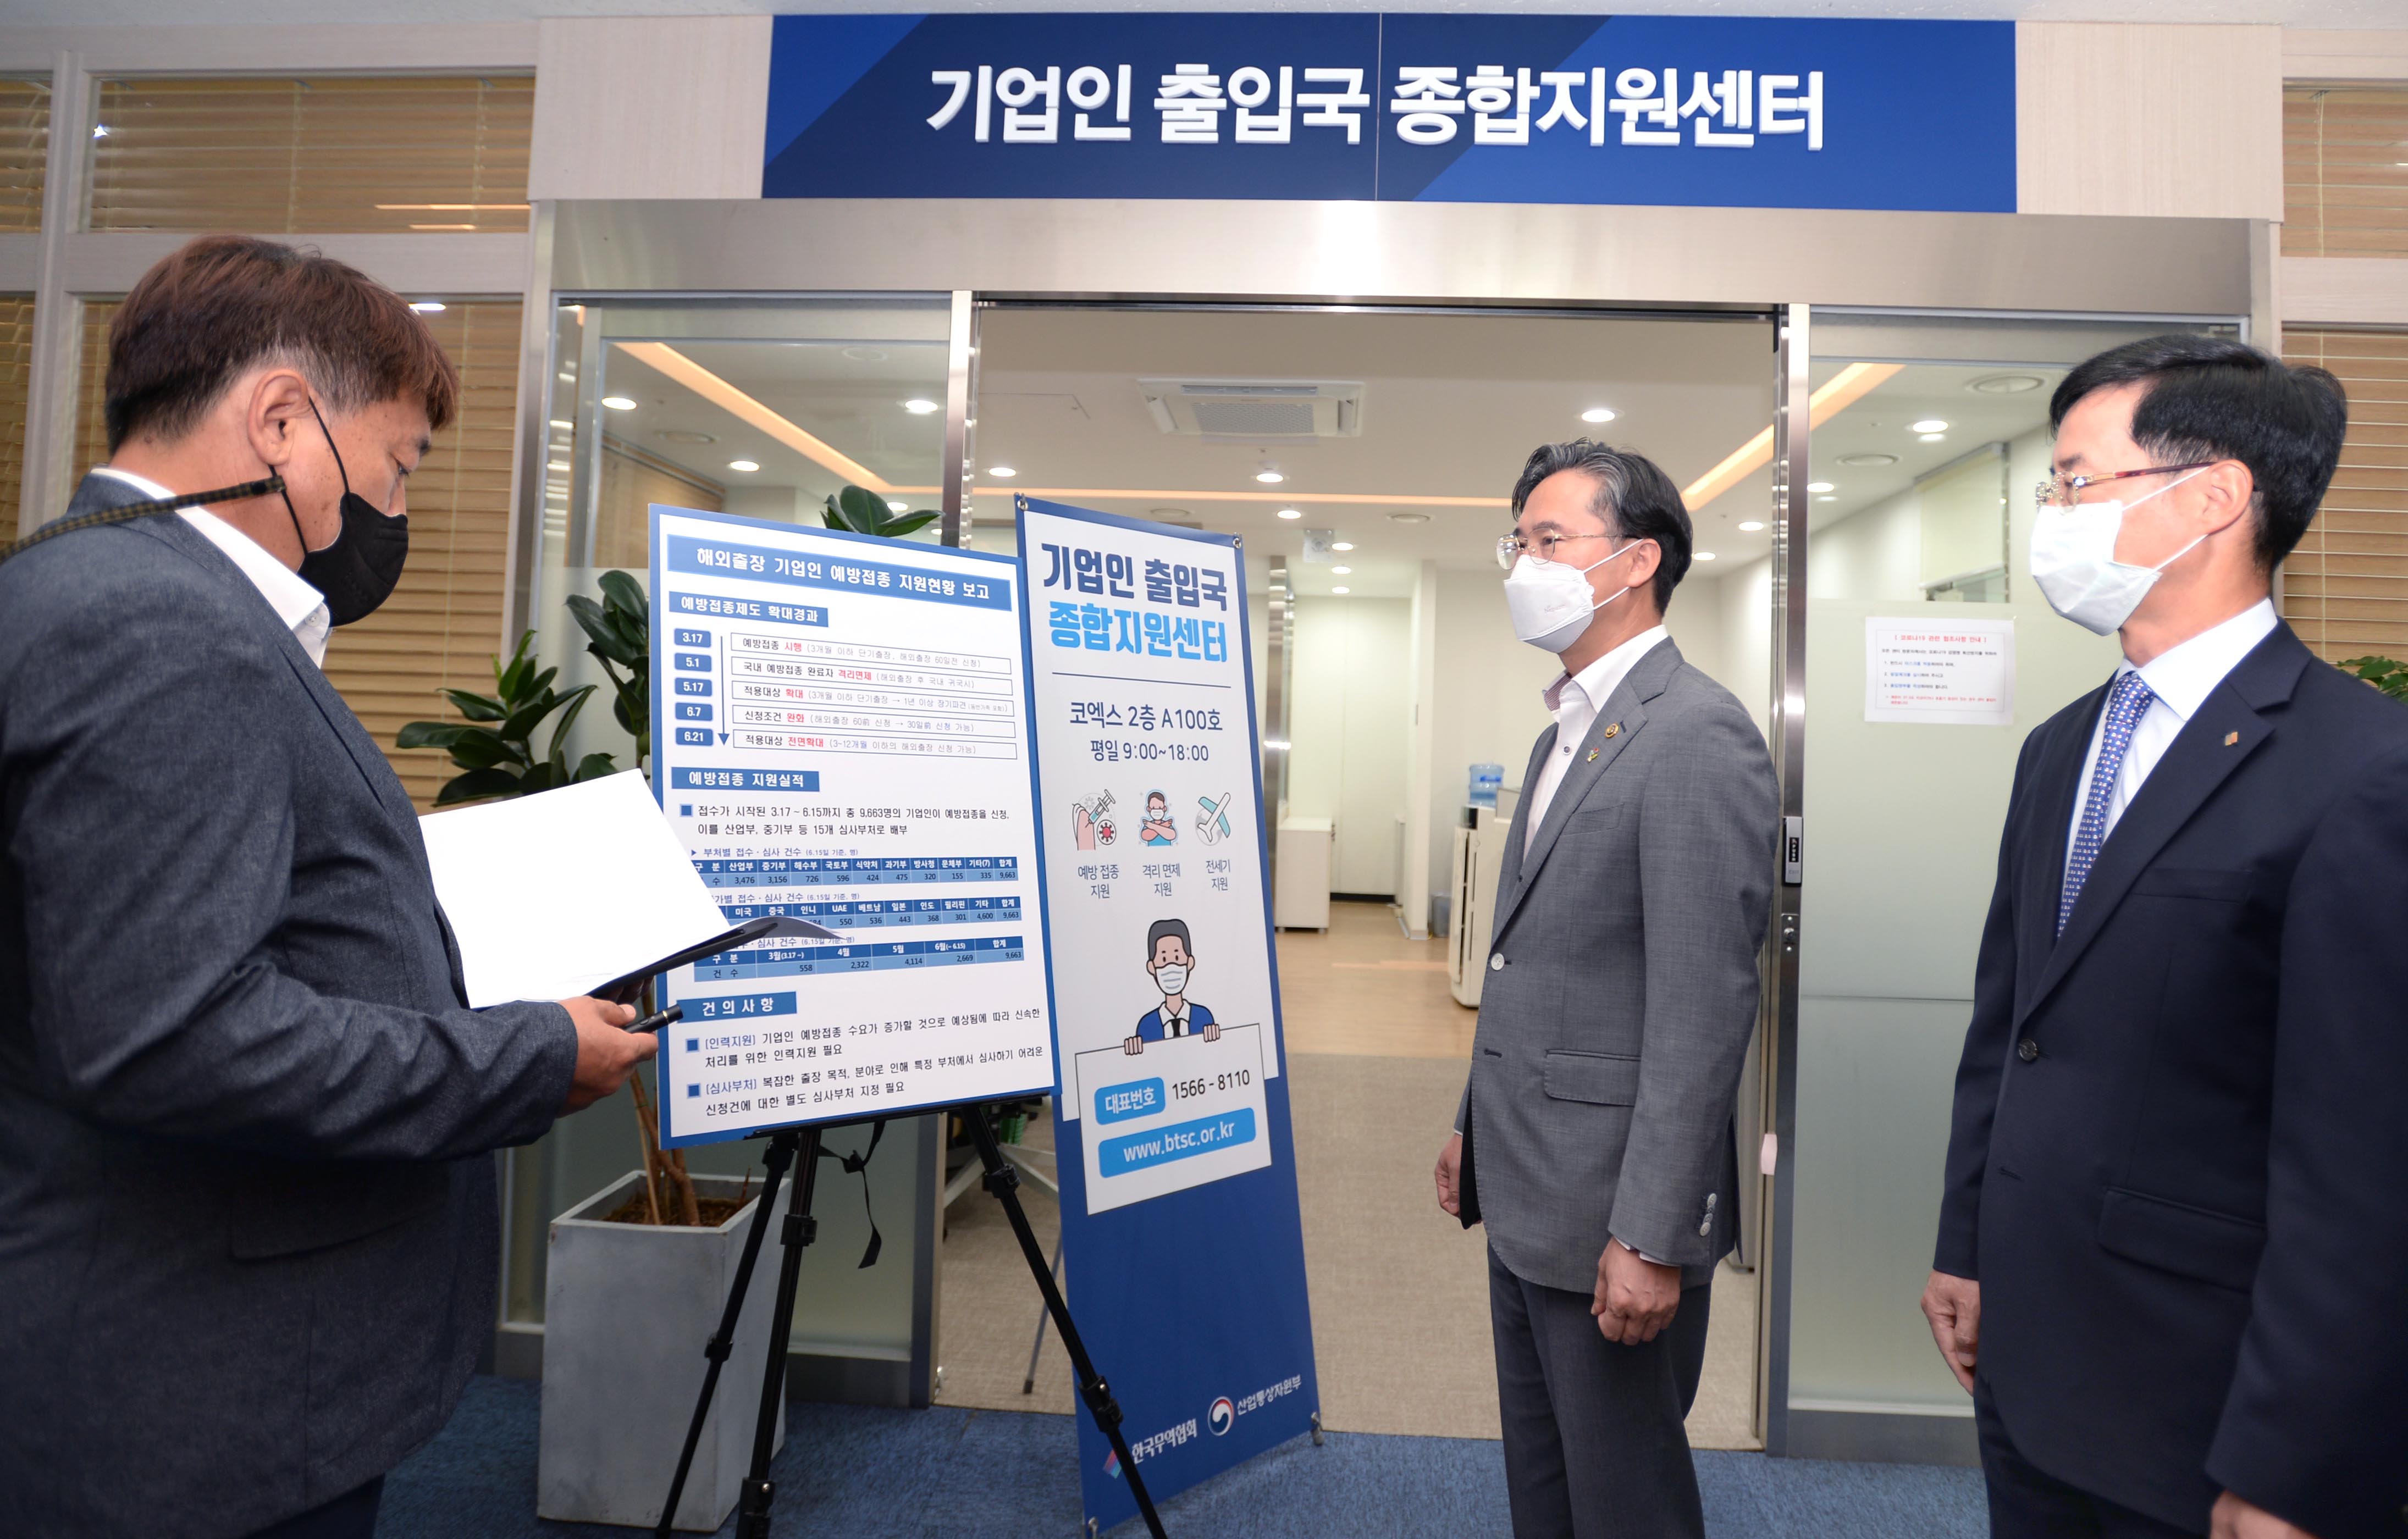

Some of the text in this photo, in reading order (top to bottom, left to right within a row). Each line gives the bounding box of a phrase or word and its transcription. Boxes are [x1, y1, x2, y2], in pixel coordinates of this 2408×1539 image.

[926, 63, 1826, 151] 기업인 출입국 종합지원센터
[697, 548, 989, 599] 해외출장 기업인 예방접종 지원현황 보고
[1041, 543, 1227, 611] 기업인 출입국
[681, 596, 818, 622] 예방접종제도 확대경과
[683, 633, 703, 643] 3.17
[1049, 600, 1227, 663] 종합지원센터
[743, 638, 802, 652] 예방접종 시행
[686, 658, 699, 667] 5.1
[744, 662, 871, 680] 국내 예방접종 완료자 격리면제
[683, 682, 703, 692] 5.17
[744, 687, 803, 698] 적용대상 확대
[687, 707, 701, 717] 6.7
[745, 711, 804, 723] 신청조건 완화
[1070, 701, 1223, 732] 코엑스 2층 A100호
[684, 732, 703, 741] 6.21
[745, 735, 782, 746] 적용대상
[788, 737, 824, 747] 전면확대
[872, 741, 896, 750] 이하의
[902, 744, 932, 752] 해외출장
[1091, 740, 1119, 762] 평일
[689, 772, 804, 787] 예방접종 지원실적
[698, 806, 730, 816] 접수가
[736, 806, 765, 817] 시작된
[771, 807, 790, 816] 3.17
[803, 808, 841, 817] 6.15까지
[846, 808, 854, 818] 총
[906, 809, 940, 818] 기업인이
[945, 810, 986, 819] 예방접종을
[698, 824, 718, 834] 이를
[764, 825, 793, 835] 중기부
[798, 825, 807, 835] 등
[814, 826, 833, 835] 15개
[839, 825, 885, 835] 심사부처로
[891, 826, 907, 835] 배부
[704, 849, 731, 857] 부처별
[763, 848, 780, 856] 심사
[785, 848, 801, 856] 건수
[729, 863, 753, 871] 산업부
[762, 862, 786, 871] 중기부
[794, 861, 818, 870] 해수부
[825, 861, 848, 870] 국토부
[856, 861, 878, 869] 식약처
[1078, 864, 1119, 880] 예방 접종
[1143, 862, 1181, 878] 격리 면제
[1206, 859, 1230, 873] 전세기
[1091, 883, 1109, 898] 지원
[1155, 882, 1172, 897] 지원
[1212, 876, 1228, 892] 지원
[736, 907, 752, 916] 미국
[769, 906, 784, 916] 중국
[800, 906, 816, 915] 인니
[892, 903, 906, 911] 일본
[920, 902, 934, 910] 인도
[1001, 899, 1014, 907] 합계
[838, 940, 1006, 957] 4월 5월 합계
[763, 1008, 1040, 1044] 기업인 예방접종 수요가 증가할 것으로 예상됨에 따라 신속한
[705, 1044, 842, 1068] 처리를 위한 인력지원 필요
[763, 1075, 794, 1088] 복잡한
[801, 1071, 820, 1084] 출장
[855, 1064, 883, 1078] 분야로
[890, 1062, 908, 1073] 인해
[915, 1059, 932, 1070] 특정
[938, 1055, 974, 1067] 부처에서
[979, 1050, 1013, 1063] 심사하기
[1019, 1047, 1042, 1058] 어려운
[706, 1082, 904, 1116] 신청건에 대한 별도 심사부처 지정 필요
[1105, 1087, 1156, 1114] 대표번호
[1123, 1121, 1235, 1162] www.btsc.or.kr
[1237, 1375, 1301, 1416] 산업통상자원부
[1131, 1419, 1197, 1464] 한국무역협회
